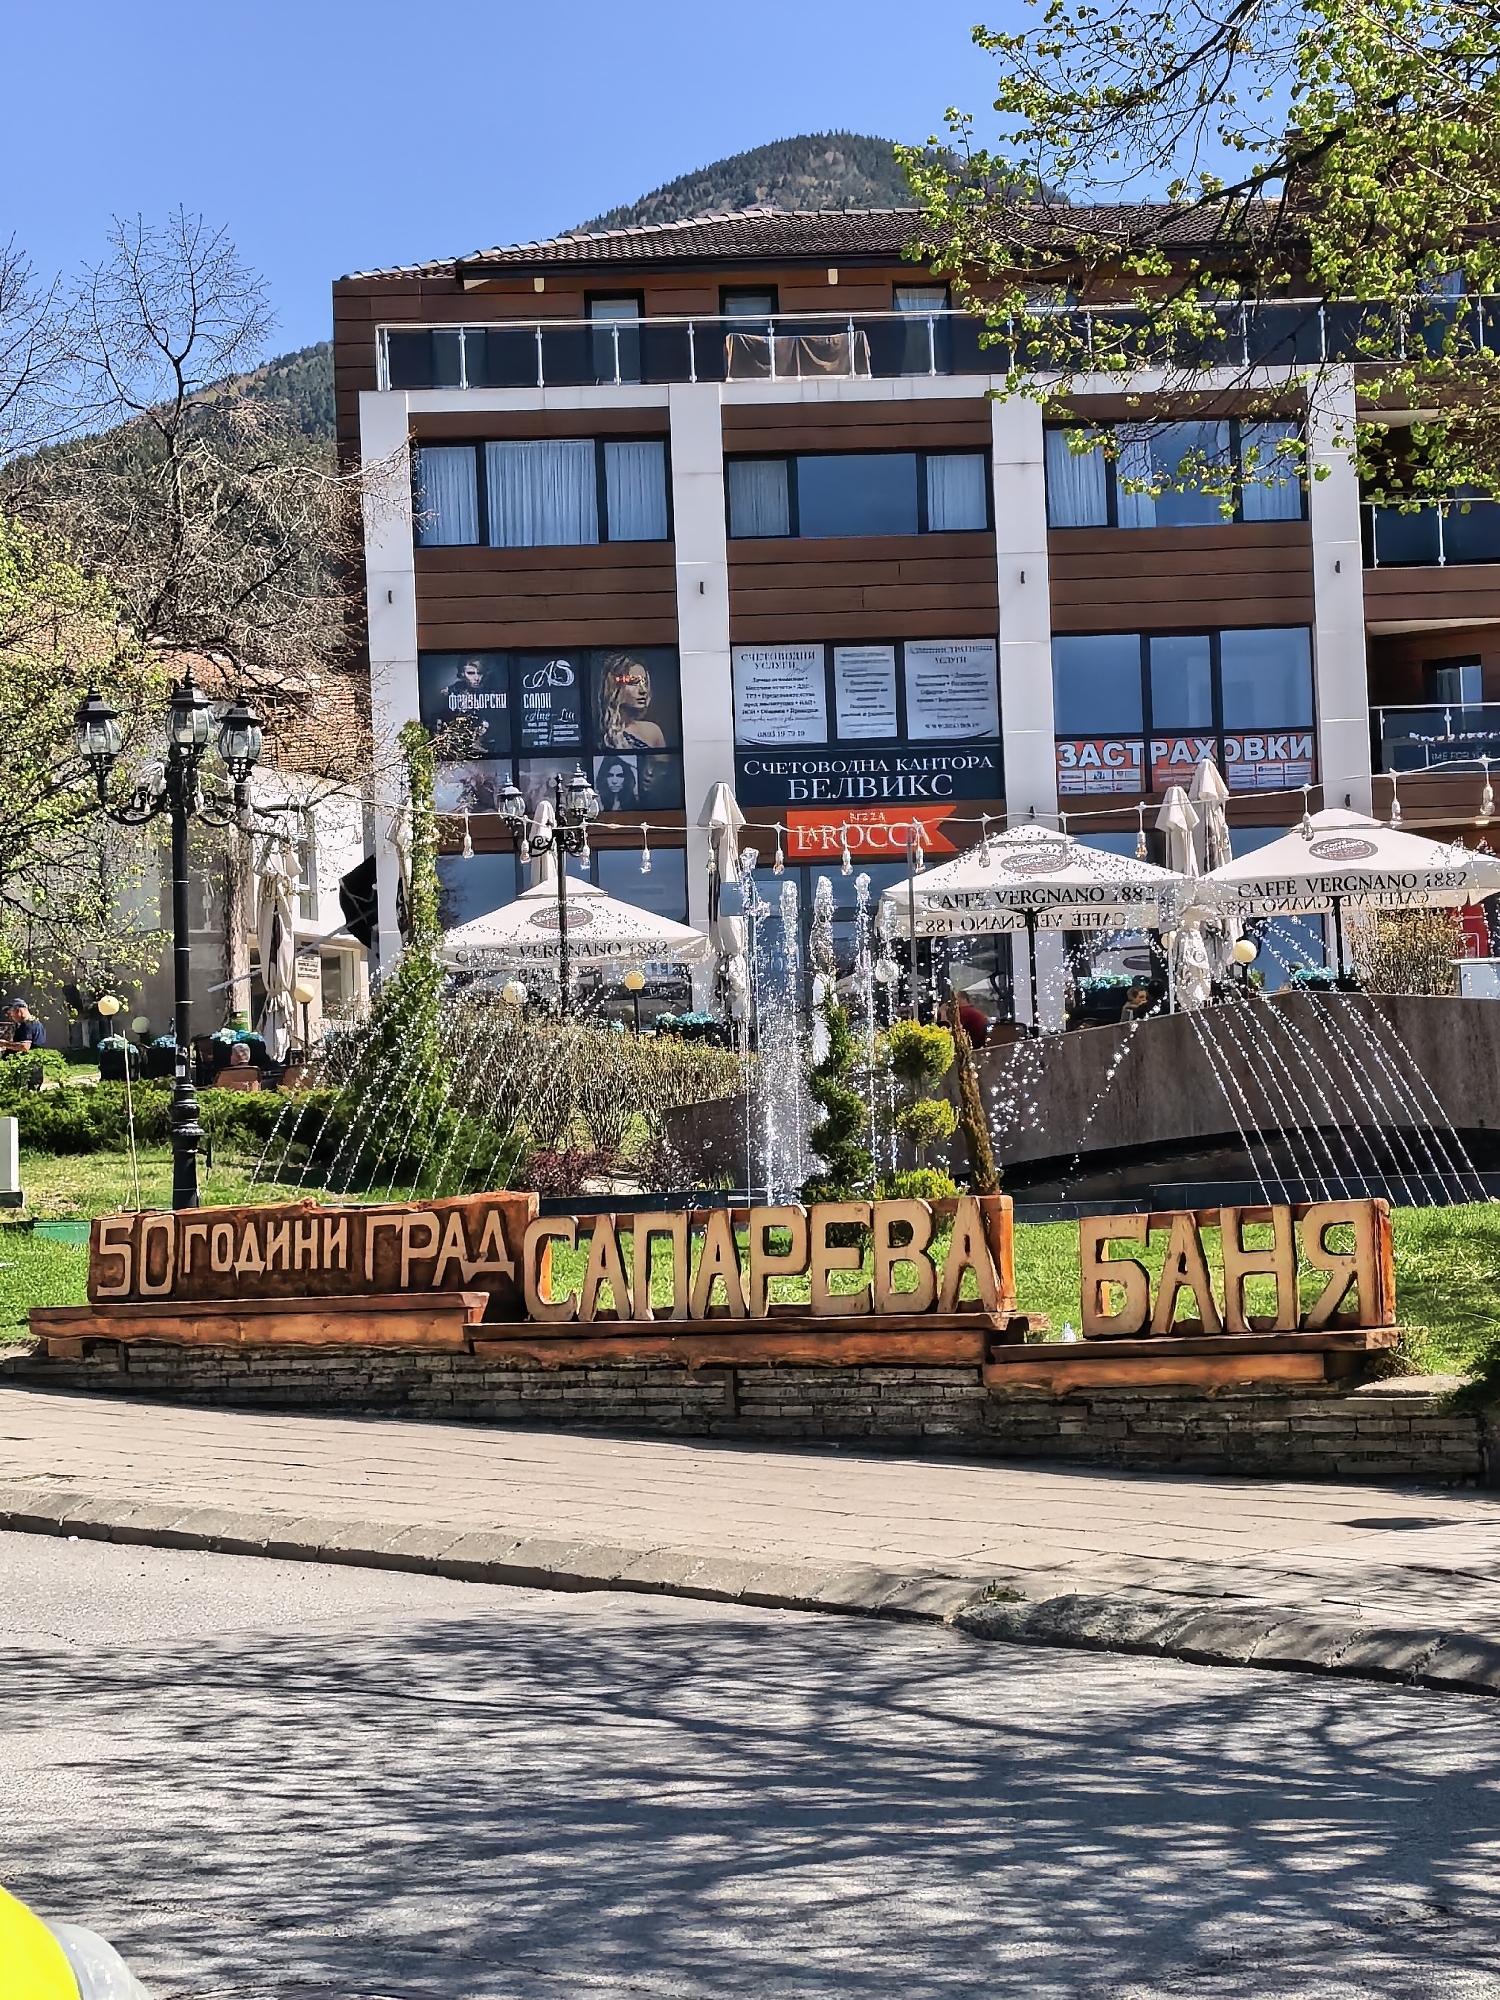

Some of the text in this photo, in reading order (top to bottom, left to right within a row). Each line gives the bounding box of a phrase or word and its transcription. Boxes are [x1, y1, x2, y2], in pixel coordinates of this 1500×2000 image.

[523, 692, 552, 709] САЛОН
[1058, 735, 1313, 767] ЗАСТРАХОВКИ
[744, 755, 994, 776] СЧЕТОВОДНА КАНТОРА
[788, 773, 953, 800] БЕЛВИКС
[1306, 873, 1417, 893] VERGNANO
[1424, 871, 1467, 889] 1882
[995, 887, 1105, 905] VERGNANO
[95, 1196, 1382, 1341] 50 ГОДИНИ ГРАД САПАРЕВА БАНЯ
